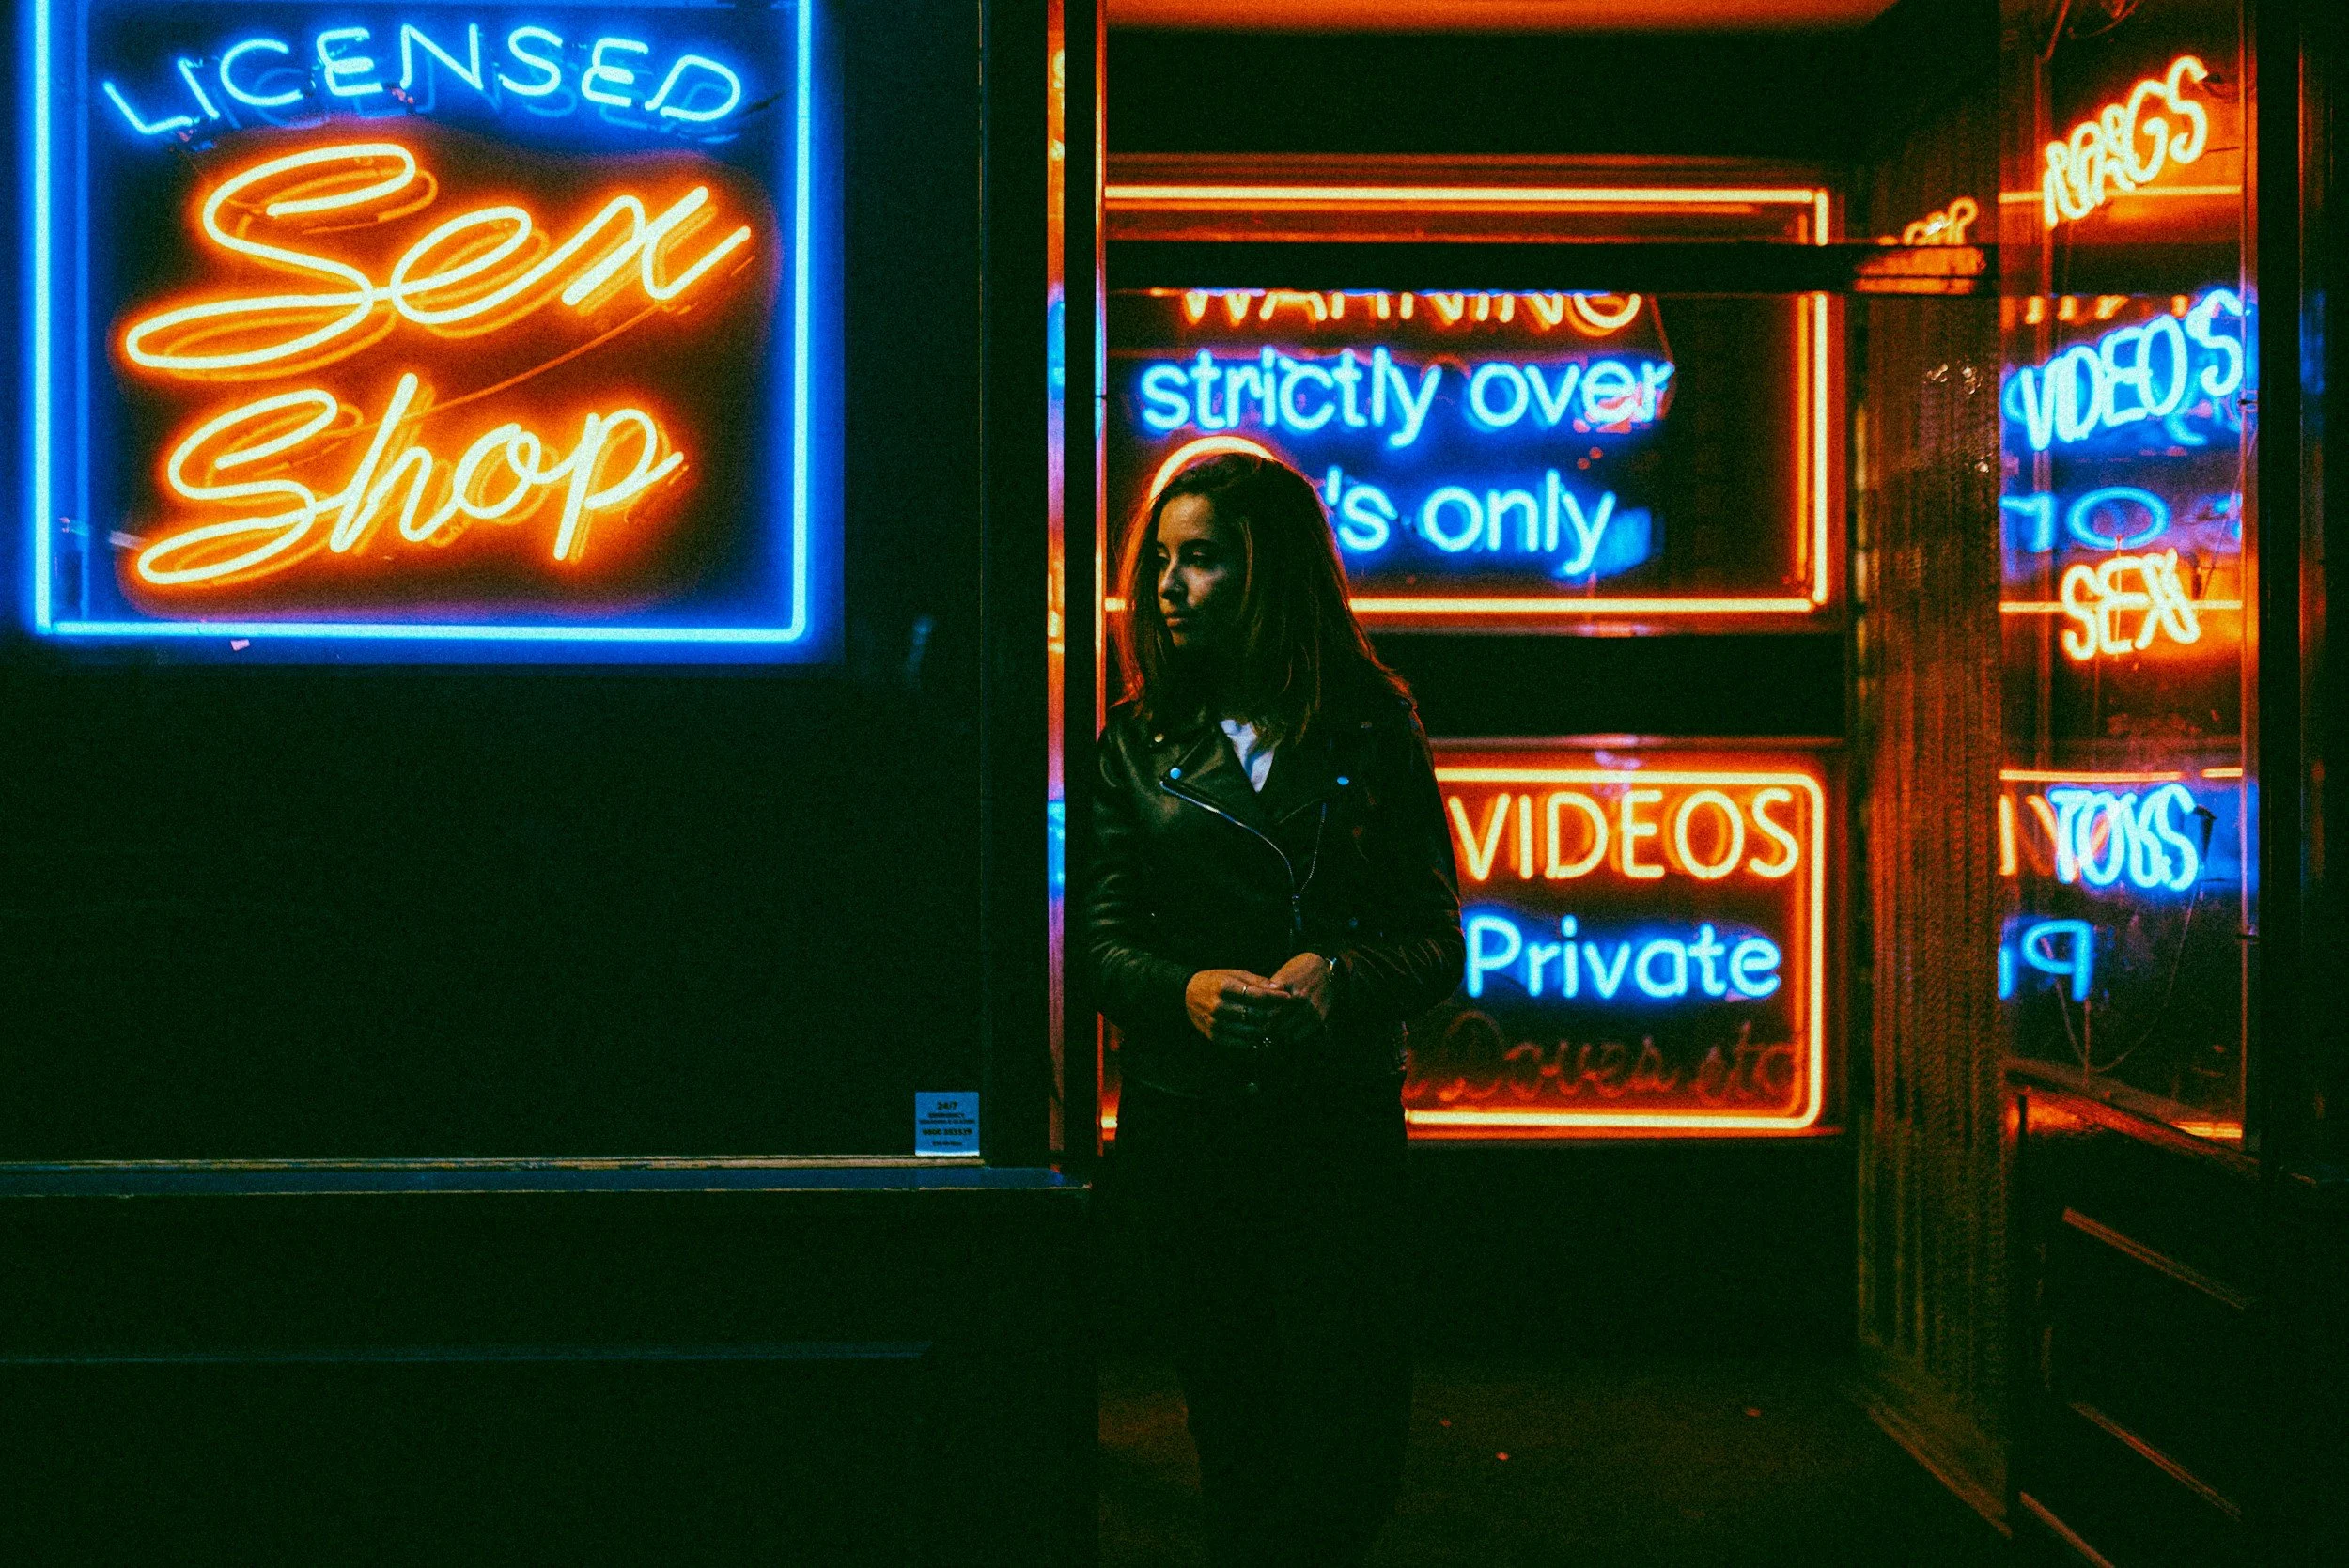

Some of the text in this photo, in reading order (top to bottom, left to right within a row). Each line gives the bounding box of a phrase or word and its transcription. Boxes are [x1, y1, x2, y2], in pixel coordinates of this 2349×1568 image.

[104, 23, 742, 134] LICENSED
[125, 143, 752, 369] Sex
[1139, 347, 1675, 447] strictly over
[2018, 288, 2244, 451] VIDEOS
[137, 373, 686, 585] Shop
[1324, 466, 1618, 577] 's only
[1447, 787, 1800, 881] VIDEOS
[1464, 914, 1783, 1000] Private
